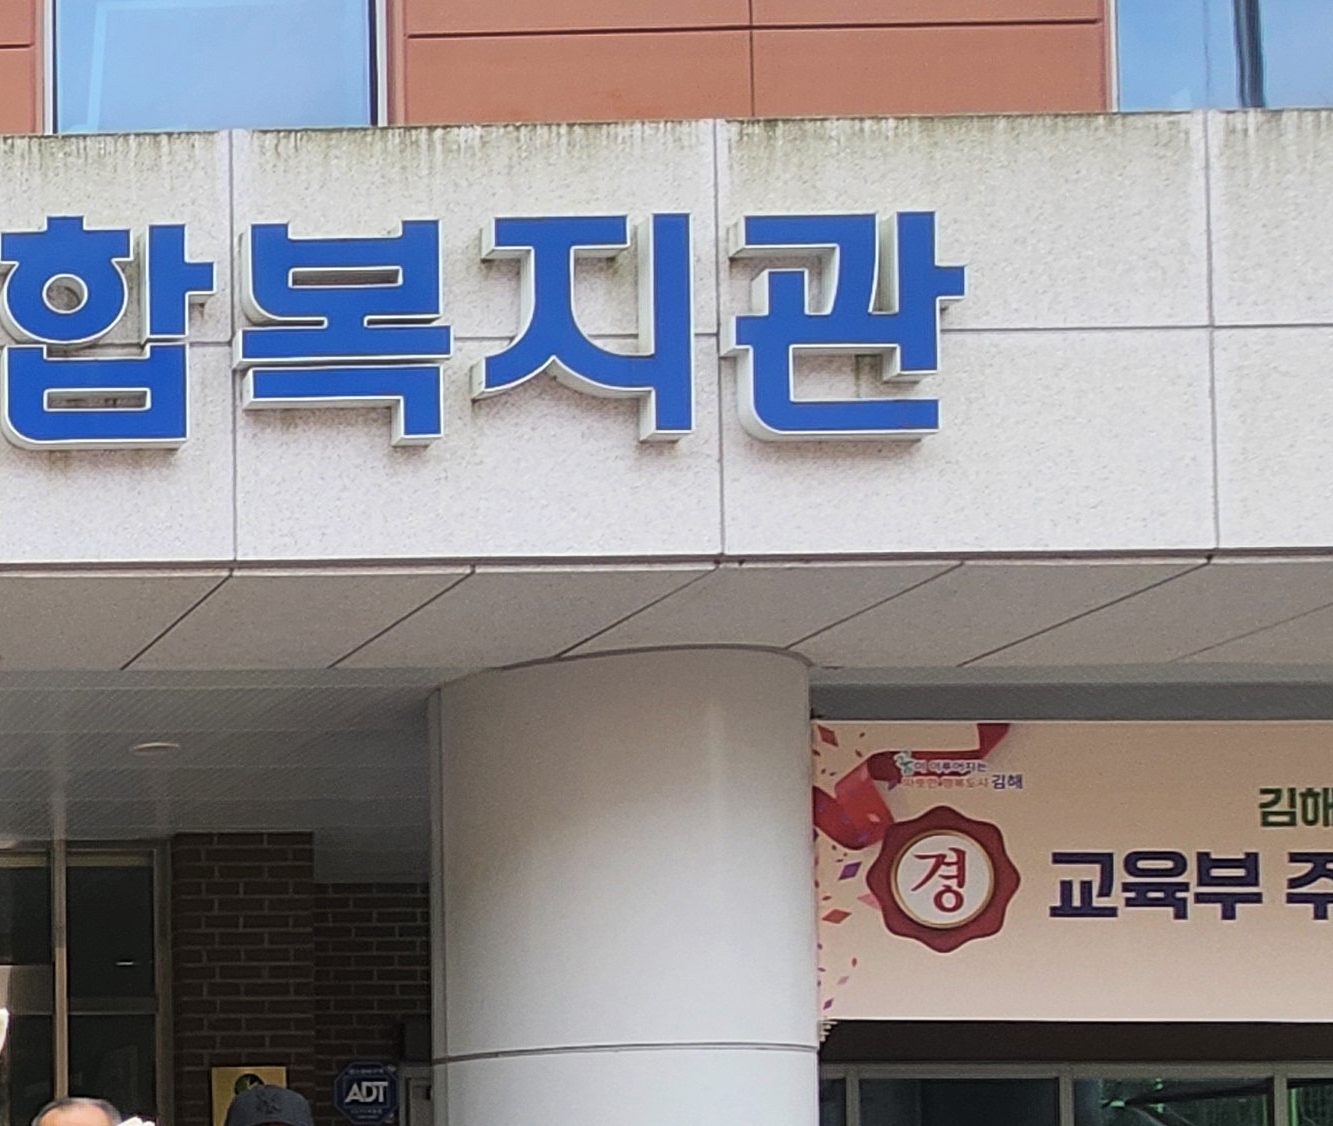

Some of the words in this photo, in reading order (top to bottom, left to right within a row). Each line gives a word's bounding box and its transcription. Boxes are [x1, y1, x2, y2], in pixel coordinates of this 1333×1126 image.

[992, 774, 1024, 789] 김해
[912, 848, 966, 913] 경
[1049, 851, 1263, 920] 교육부
[344, 1081, 389, 1103] ADT
